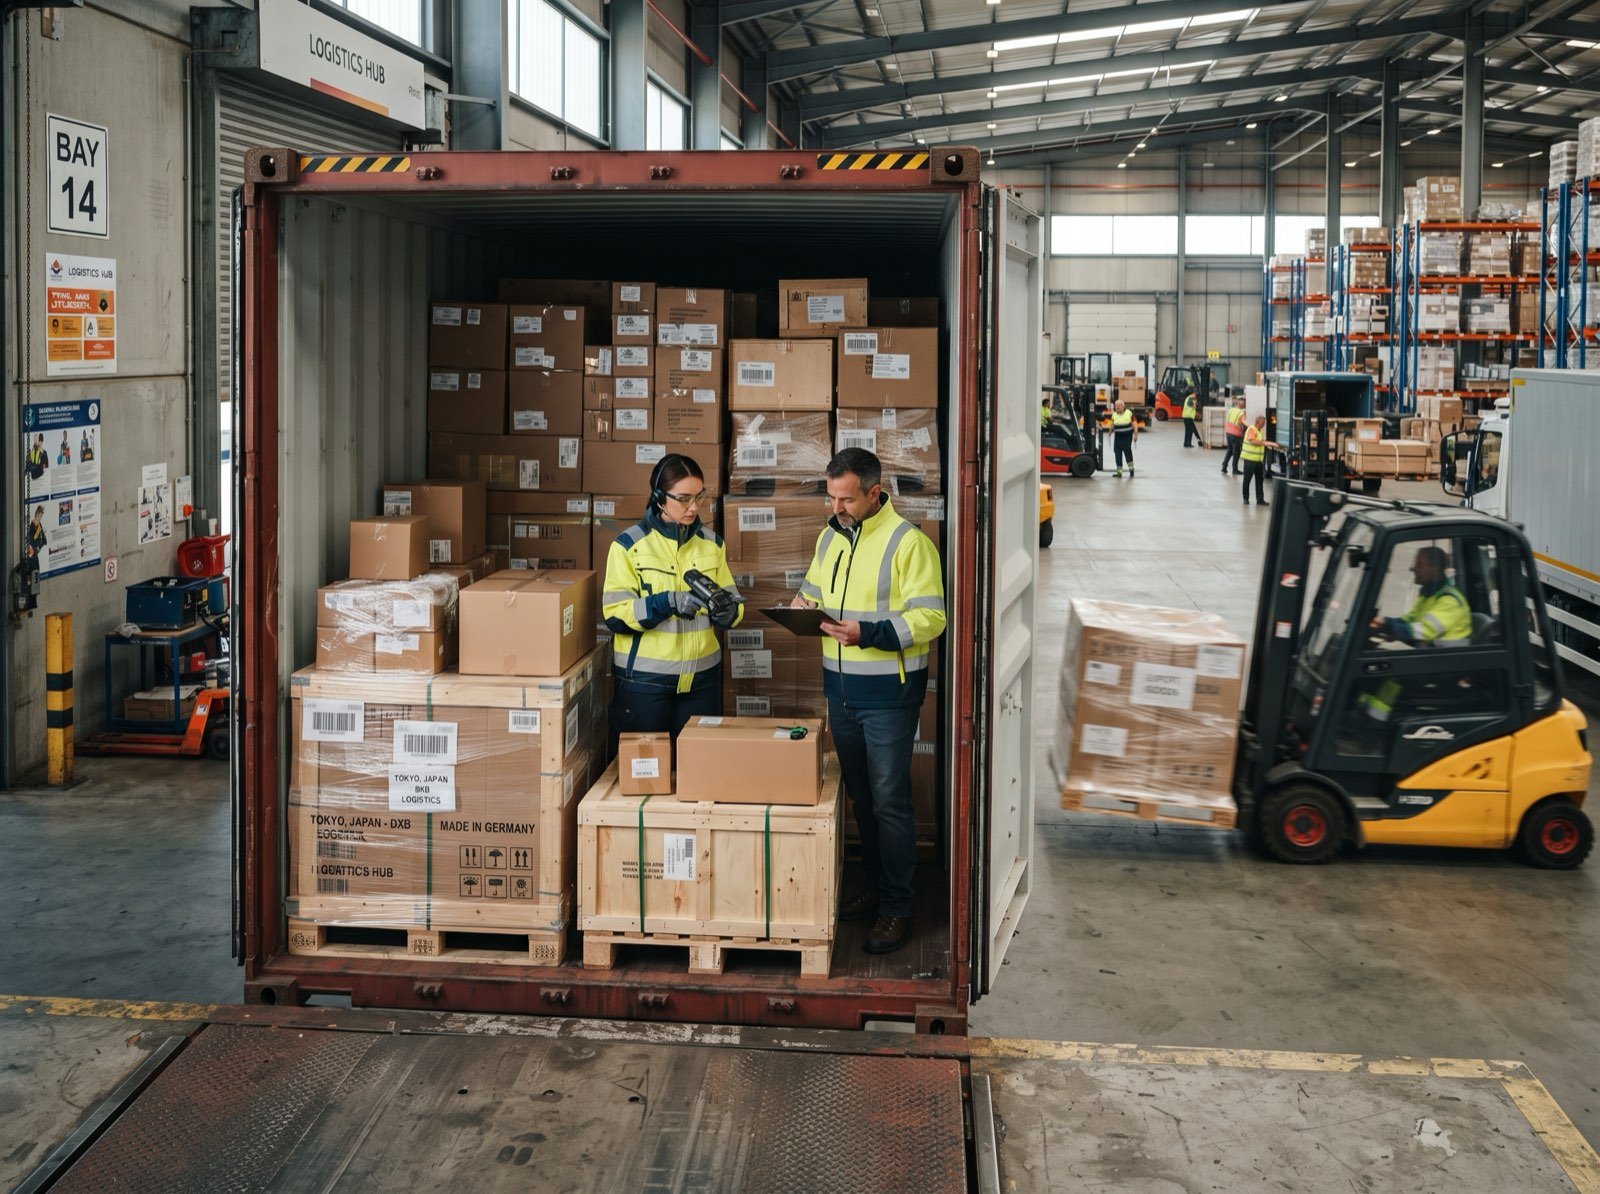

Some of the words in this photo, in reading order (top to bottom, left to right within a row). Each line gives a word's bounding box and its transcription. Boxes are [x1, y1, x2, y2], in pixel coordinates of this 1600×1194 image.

[309, 33, 363, 75] LOGISTICS
[365, 58, 386, 84] HUB
[57, 131, 100, 168] BAY
[62, 175, 97, 222] 14
[68, 267, 100, 278] LOGISTICS
[90, 406, 96, 416] 3
[394, 774, 422, 783] TOKYO,
[423, 775, 448, 783] JAPAN
[401, 796, 441, 804] LOGISTICS
[311, 815, 348, 828] TOKYO,
[349, 816, 382, 828] JAPAN
[390, 818, 412, 829] DXB
[440, 820, 469, 832] MADE
[472, 821, 482, 832] IN
[484, 822, 536, 834] GERMANY
[372, 867, 394, 878] HUB
